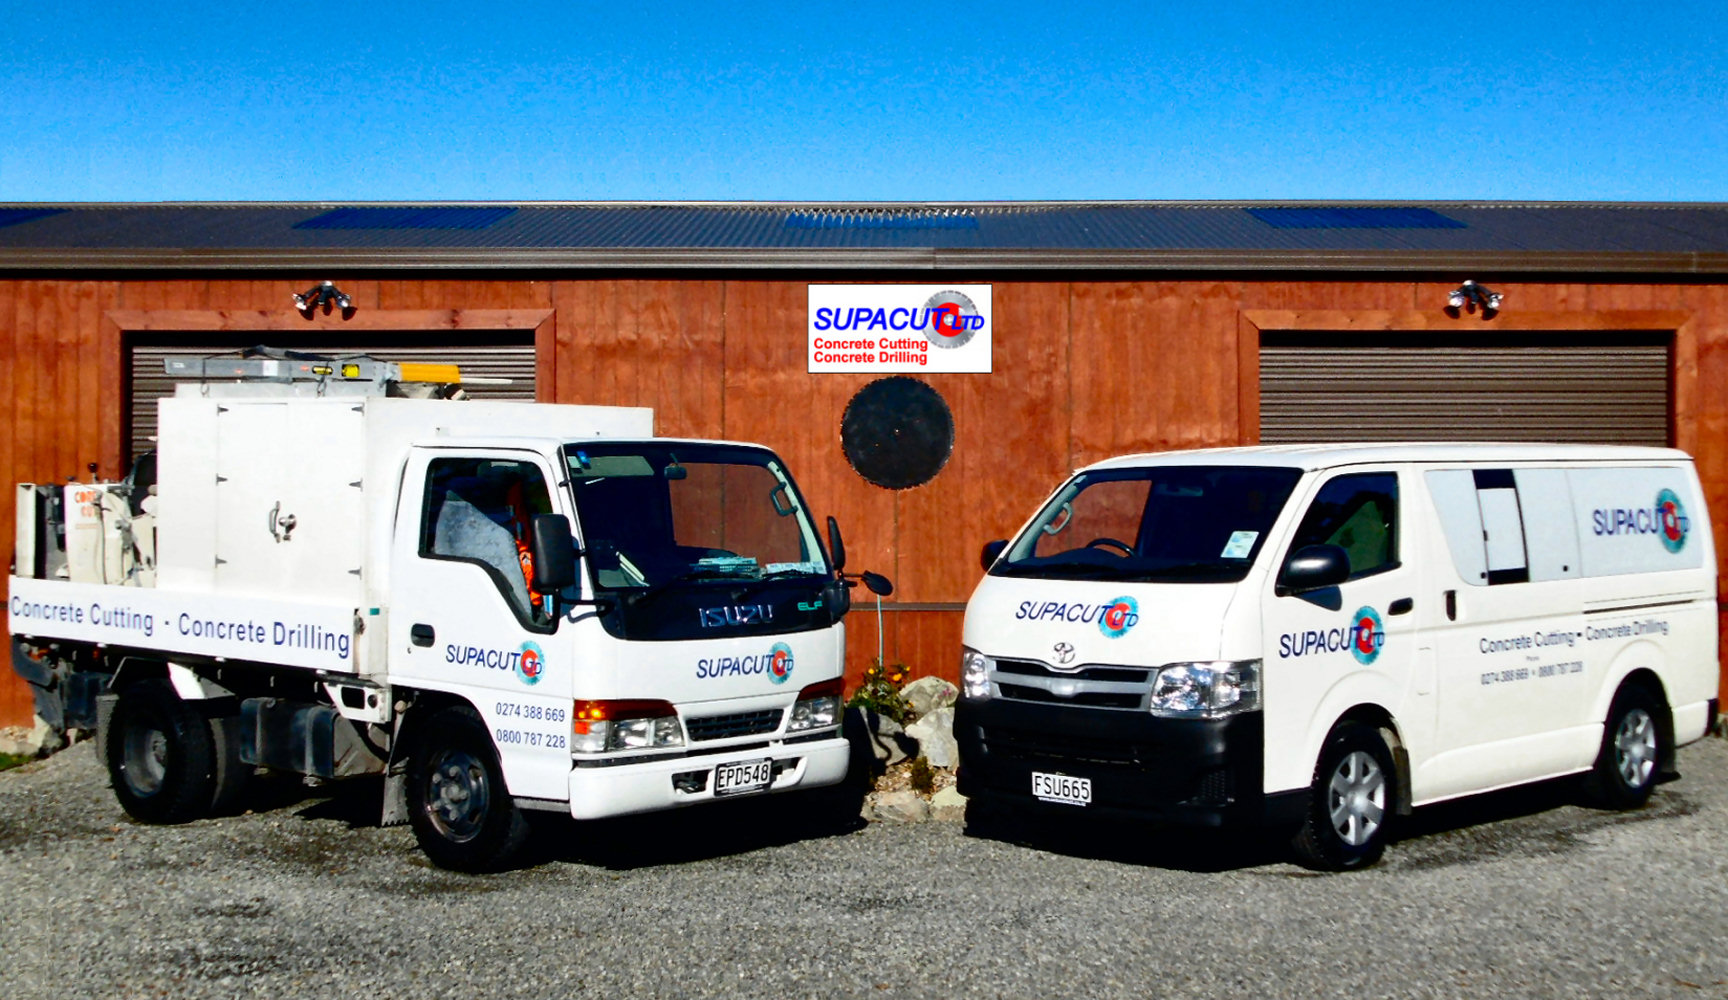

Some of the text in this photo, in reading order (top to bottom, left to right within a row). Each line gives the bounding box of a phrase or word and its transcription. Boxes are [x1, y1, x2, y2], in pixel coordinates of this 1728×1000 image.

[814, 307, 985, 331] SUPACUT LTD
[814, 338, 928, 352] Concrete Cutting
[814, 351, 928, 366] Concrete Drilling
[699, 605, 773, 628] ISUZU
[1015, 601, 1115, 625] SUPACUT
[10, 596, 350, 659] Concrete Cutting Concrete Drilling
[1480, 638, 1532, 654] Concrete
[1534, 630, 1574, 647] Cutting
[1586, 625, 1632, 640] Concrete
[1279, 627, 1364, 659] SUPACUT
[446, 644, 521, 672] SUPACUT
[697, 654, 774, 678] SUPACUT
[496, 702, 565, 722] 0274 388 669
[496, 729, 566, 748] 0800 787 228
[718, 764, 769, 788] EPD548
[1034, 775, 1090, 800] FSU665
